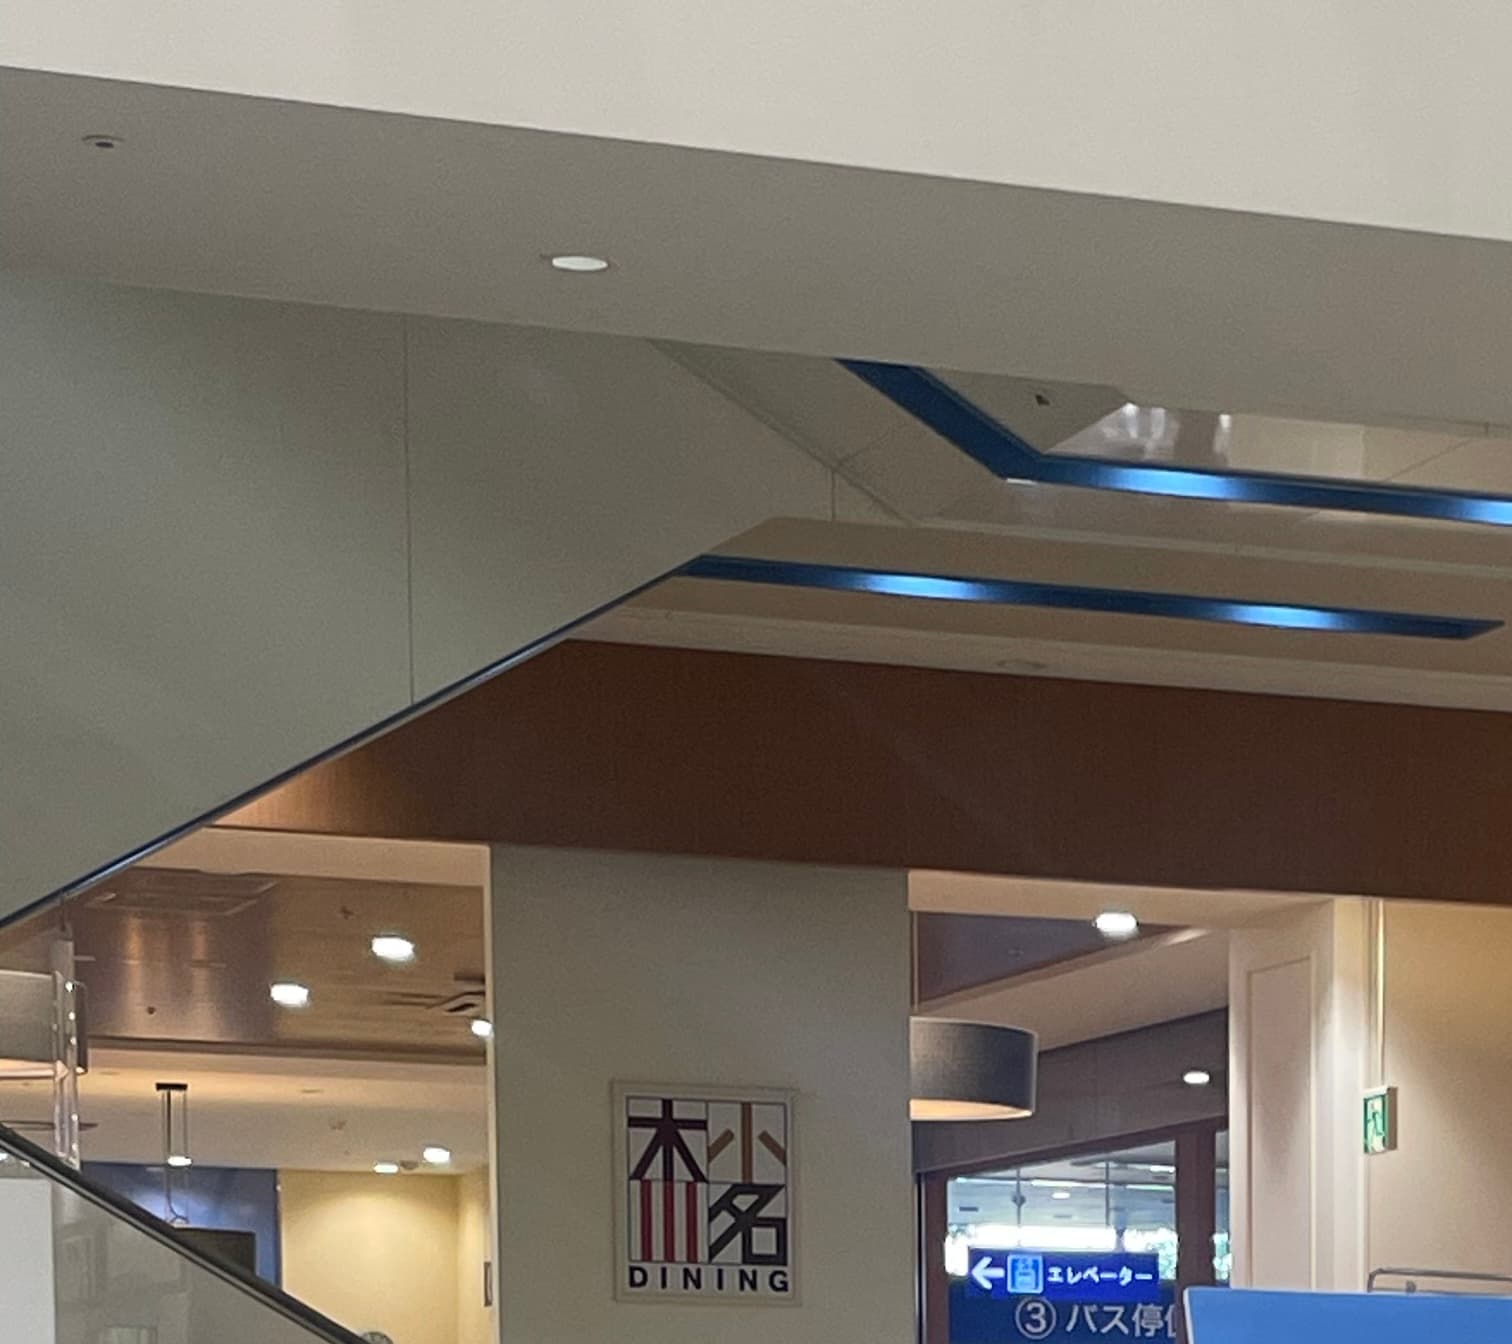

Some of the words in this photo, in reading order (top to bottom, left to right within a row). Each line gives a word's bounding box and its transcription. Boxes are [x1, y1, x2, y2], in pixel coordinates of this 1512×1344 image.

[628, 1265, 789, 1293] DINING
[1047, 1266, 1153, 1290] エレベーター
